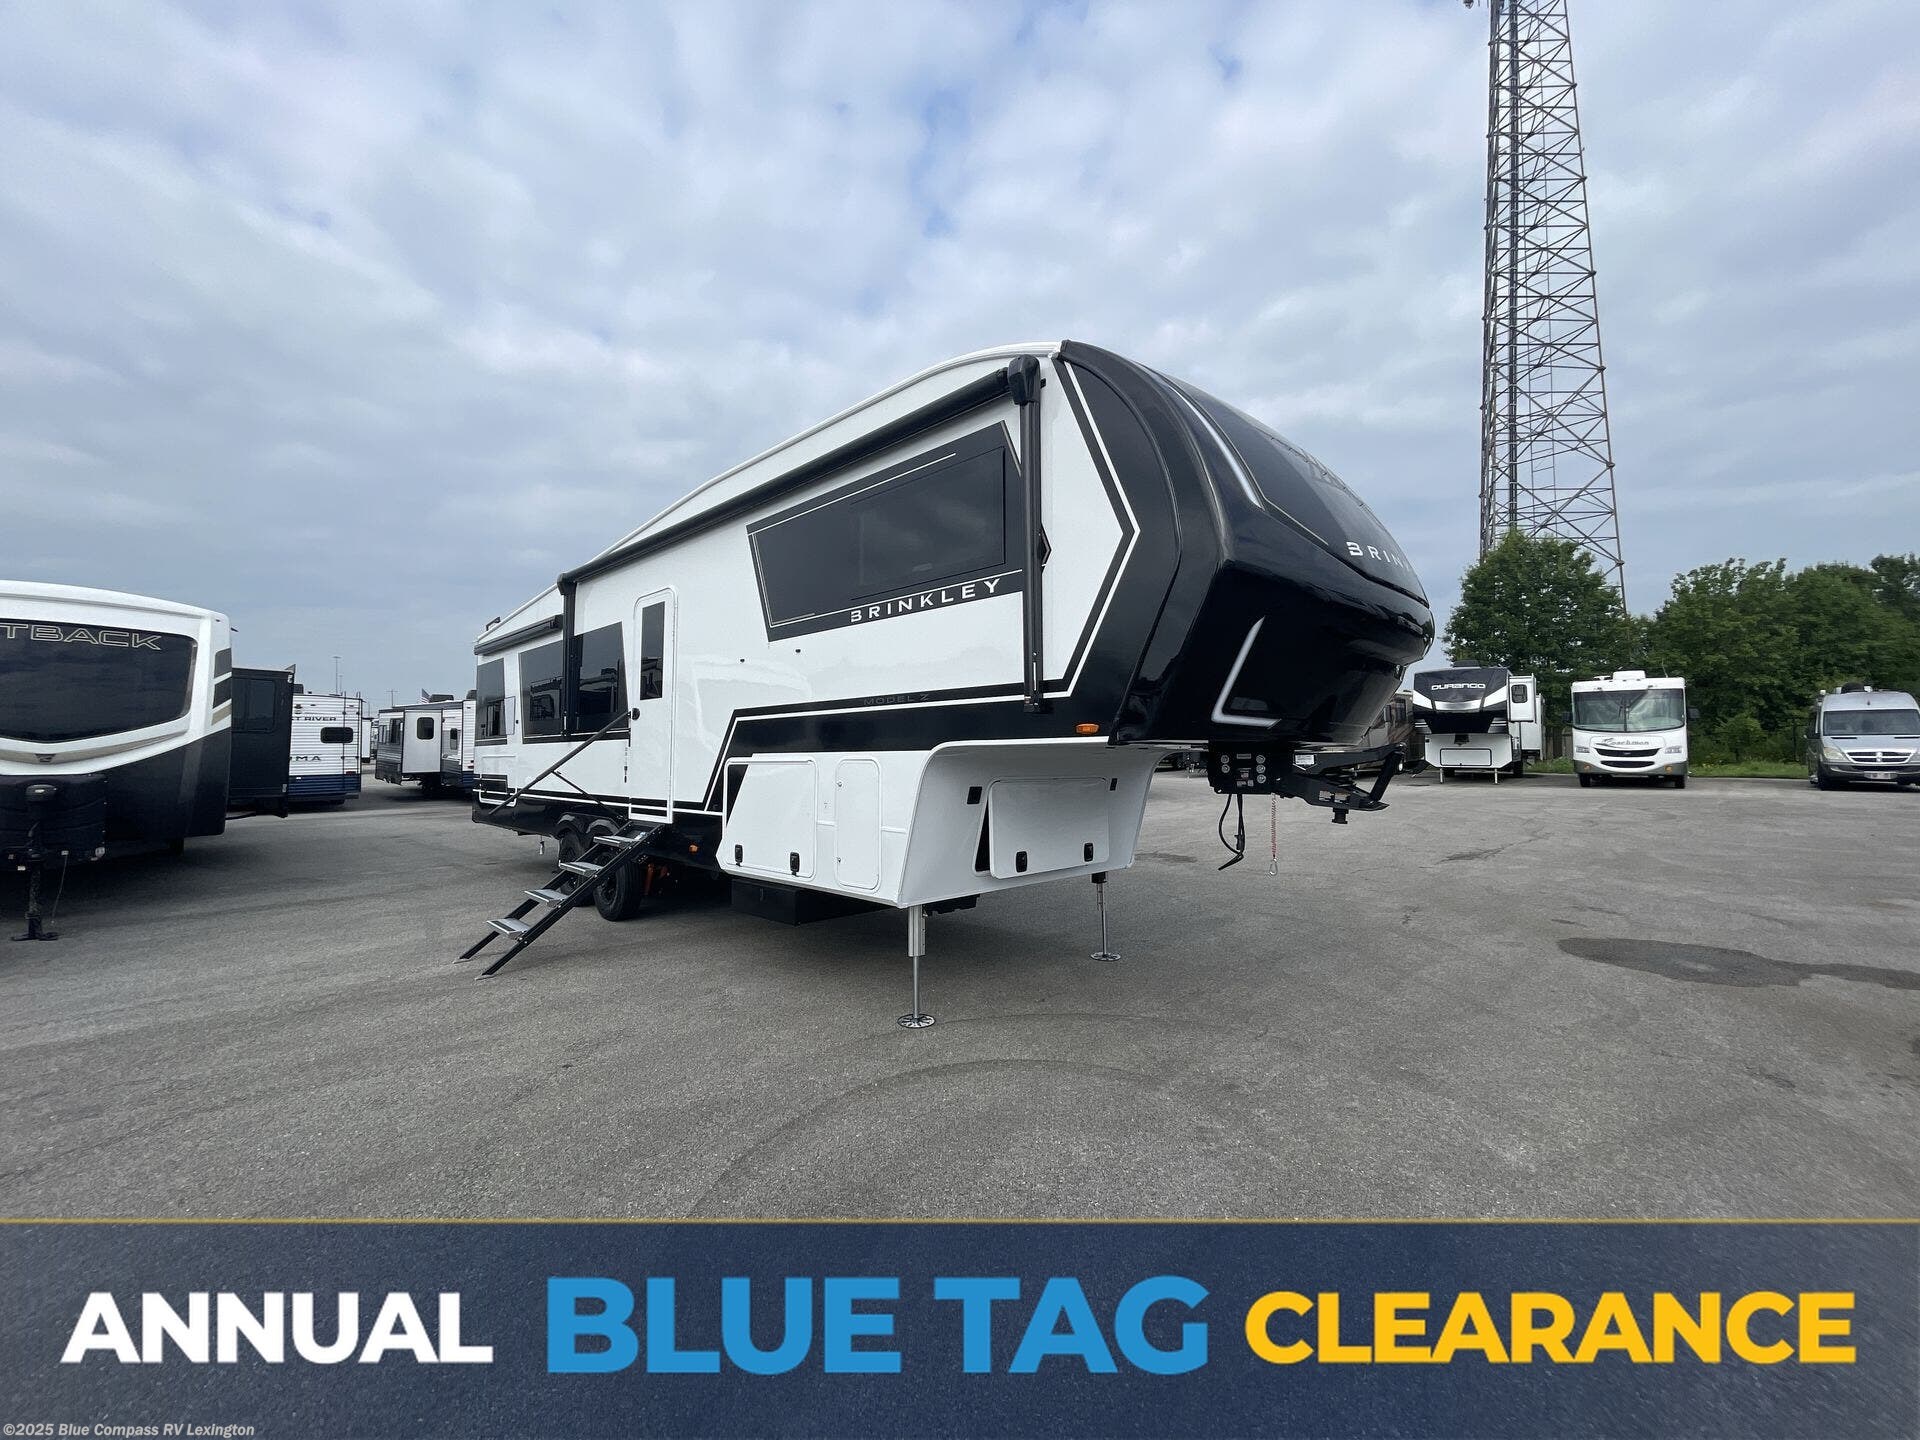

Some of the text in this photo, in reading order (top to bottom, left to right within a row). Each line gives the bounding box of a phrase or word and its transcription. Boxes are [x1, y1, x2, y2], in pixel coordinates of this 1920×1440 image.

[850, 578, 1000, 623] BRINKLEY
[1431, 683, 1486, 691] DURANGO
[863, 695, 915, 706] MODEL
